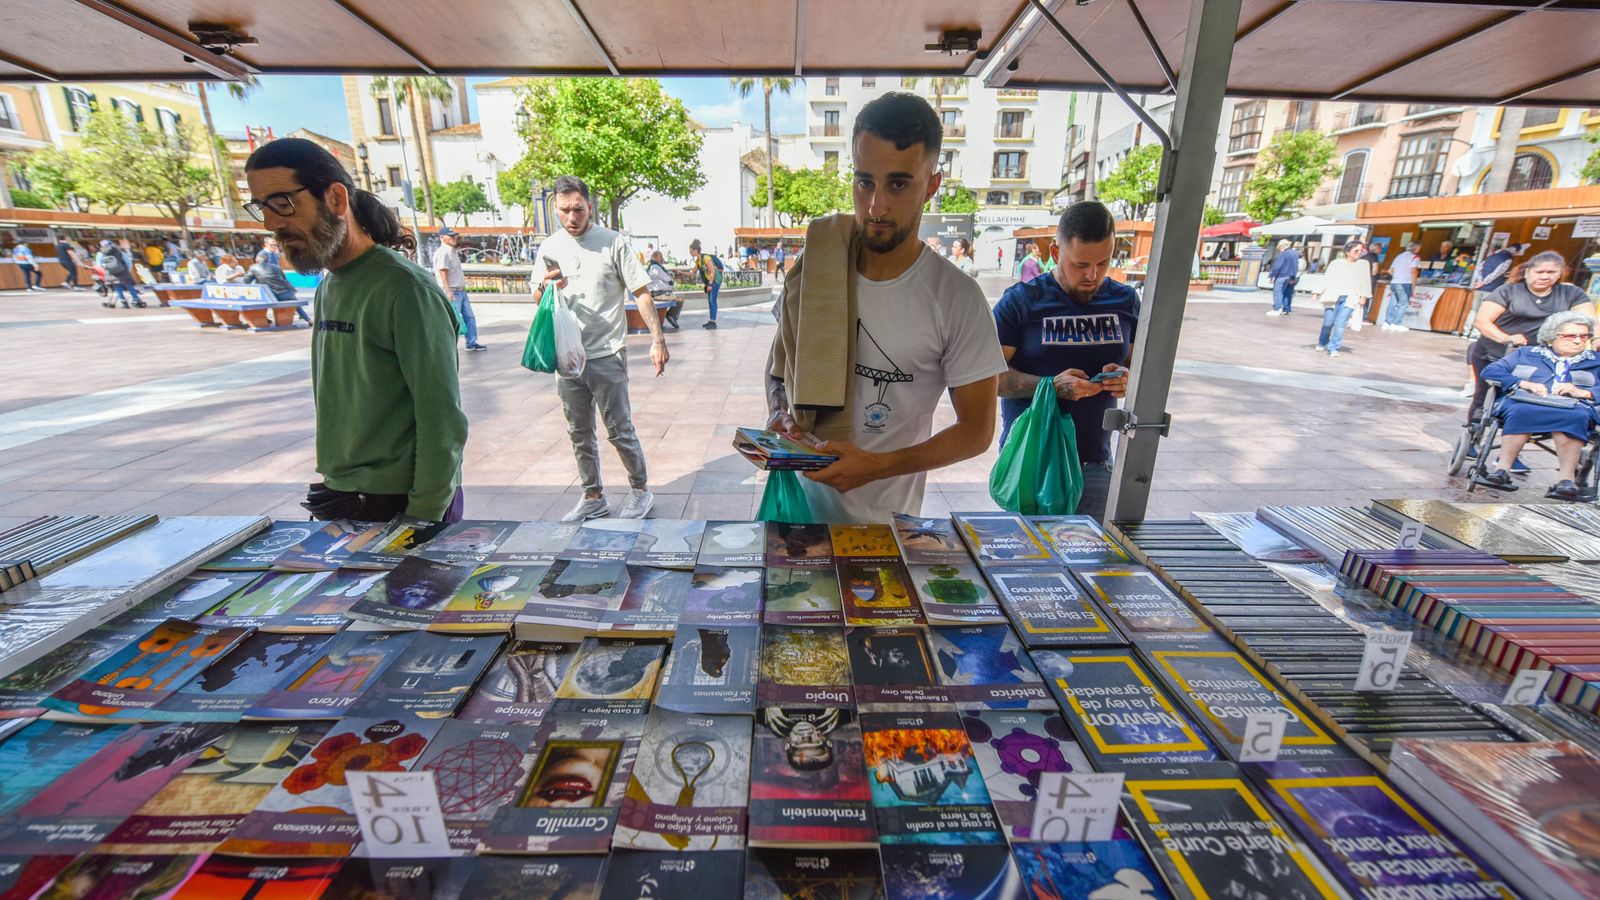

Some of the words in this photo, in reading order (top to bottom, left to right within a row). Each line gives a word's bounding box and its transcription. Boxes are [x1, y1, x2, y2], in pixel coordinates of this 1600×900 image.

[1044, 315, 1123, 342] MARVEL
[446, 552, 487, 561] Drácula
[1010, 586, 1068, 594] universo
[1011, 595, 1033, 603] del
[1034, 593, 1079, 603] origen
[1038, 603, 1052, 611] el
[1054, 601, 1063, 609] y
[1107, 602, 1160, 610] materia
[1160, 602, 1176, 610] la
[407, 612, 435, 620] Cuentos
[566, 613, 599, 622] Cumbres
[1019, 610, 1058, 620] Bang
[1055, 610, 1082, 620] Big
[1080, 611, 1096, 620] El
[1175, 610, 1191, 618] El
[91, 690, 125, 700] Gitano
[990, 688, 1047, 699] Retórica
[1062, 683, 1140, 698] gravedad
[1141, 685, 1160, 697] la
[308, 697, 339, 705] Faro
[805, 691, 849, 702] Utopía
[1187, 691, 1255, 703] método
[1255, 691, 1272, 704] el
[1271, 690, 1287, 702] y
[102, 699, 154, 708] Romancero
[340, 697, 357, 707] Al
[1079, 700, 1102, 712] de
[1105, 697, 1130, 710] ley
[1130, 698, 1149, 710] la
[1149, 696, 1161, 708] y
[495, 705, 544, 717] Príncipe
[587, 706, 611, 714] Negro
[1078, 711, 1186, 729] Newton
[1297, 748, 1334, 756] NATIONAL
[1119, 756, 1166, 764] GEOGRAPHIC
[1167, 754, 1204, 763] NATIONAL
[1161, 767, 1189, 775] CIENCIA
[1299, 766, 1328, 774] CIENCIA
[695, 814, 702, 823] y
[782, 808, 867, 822] Frankenstein
[940, 812, 969, 821] Tierra
[969, 812, 979, 823] la
[980, 812, 993, 820] de
[535, 816, 609, 834] Carmilla
[703, 816, 733, 825] Colono
[961, 820, 982, 828] casa
[984, 820, 997, 829] La
[1206, 819, 1227, 831] por
[1255, 820, 1281, 831] Una
[272, 823, 326, 834] Nicómaco
[654, 822, 666, 830] en
[667, 823, 692, 833] Edipo
[713, 823, 738, 833] Edipo
[936, 821, 945, 831] el
[1148, 822, 1193, 833] ciencia
[1191, 822, 1208, 833] la
[1226, 821, 1255, 833] vida
[460, 829, 472, 837] de
[1161, 836, 1227, 857] Curie
[1224, 834, 1297, 855] Marie
[1322, 835, 1409, 858] Planck
[1396, 833, 1460, 855] Max
[521, 868, 545, 876] Plutón
[659, 864, 684, 873] Plutón
[1346, 860, 1382, 881] de
[1377, 855, 1478, 879] cuántica
